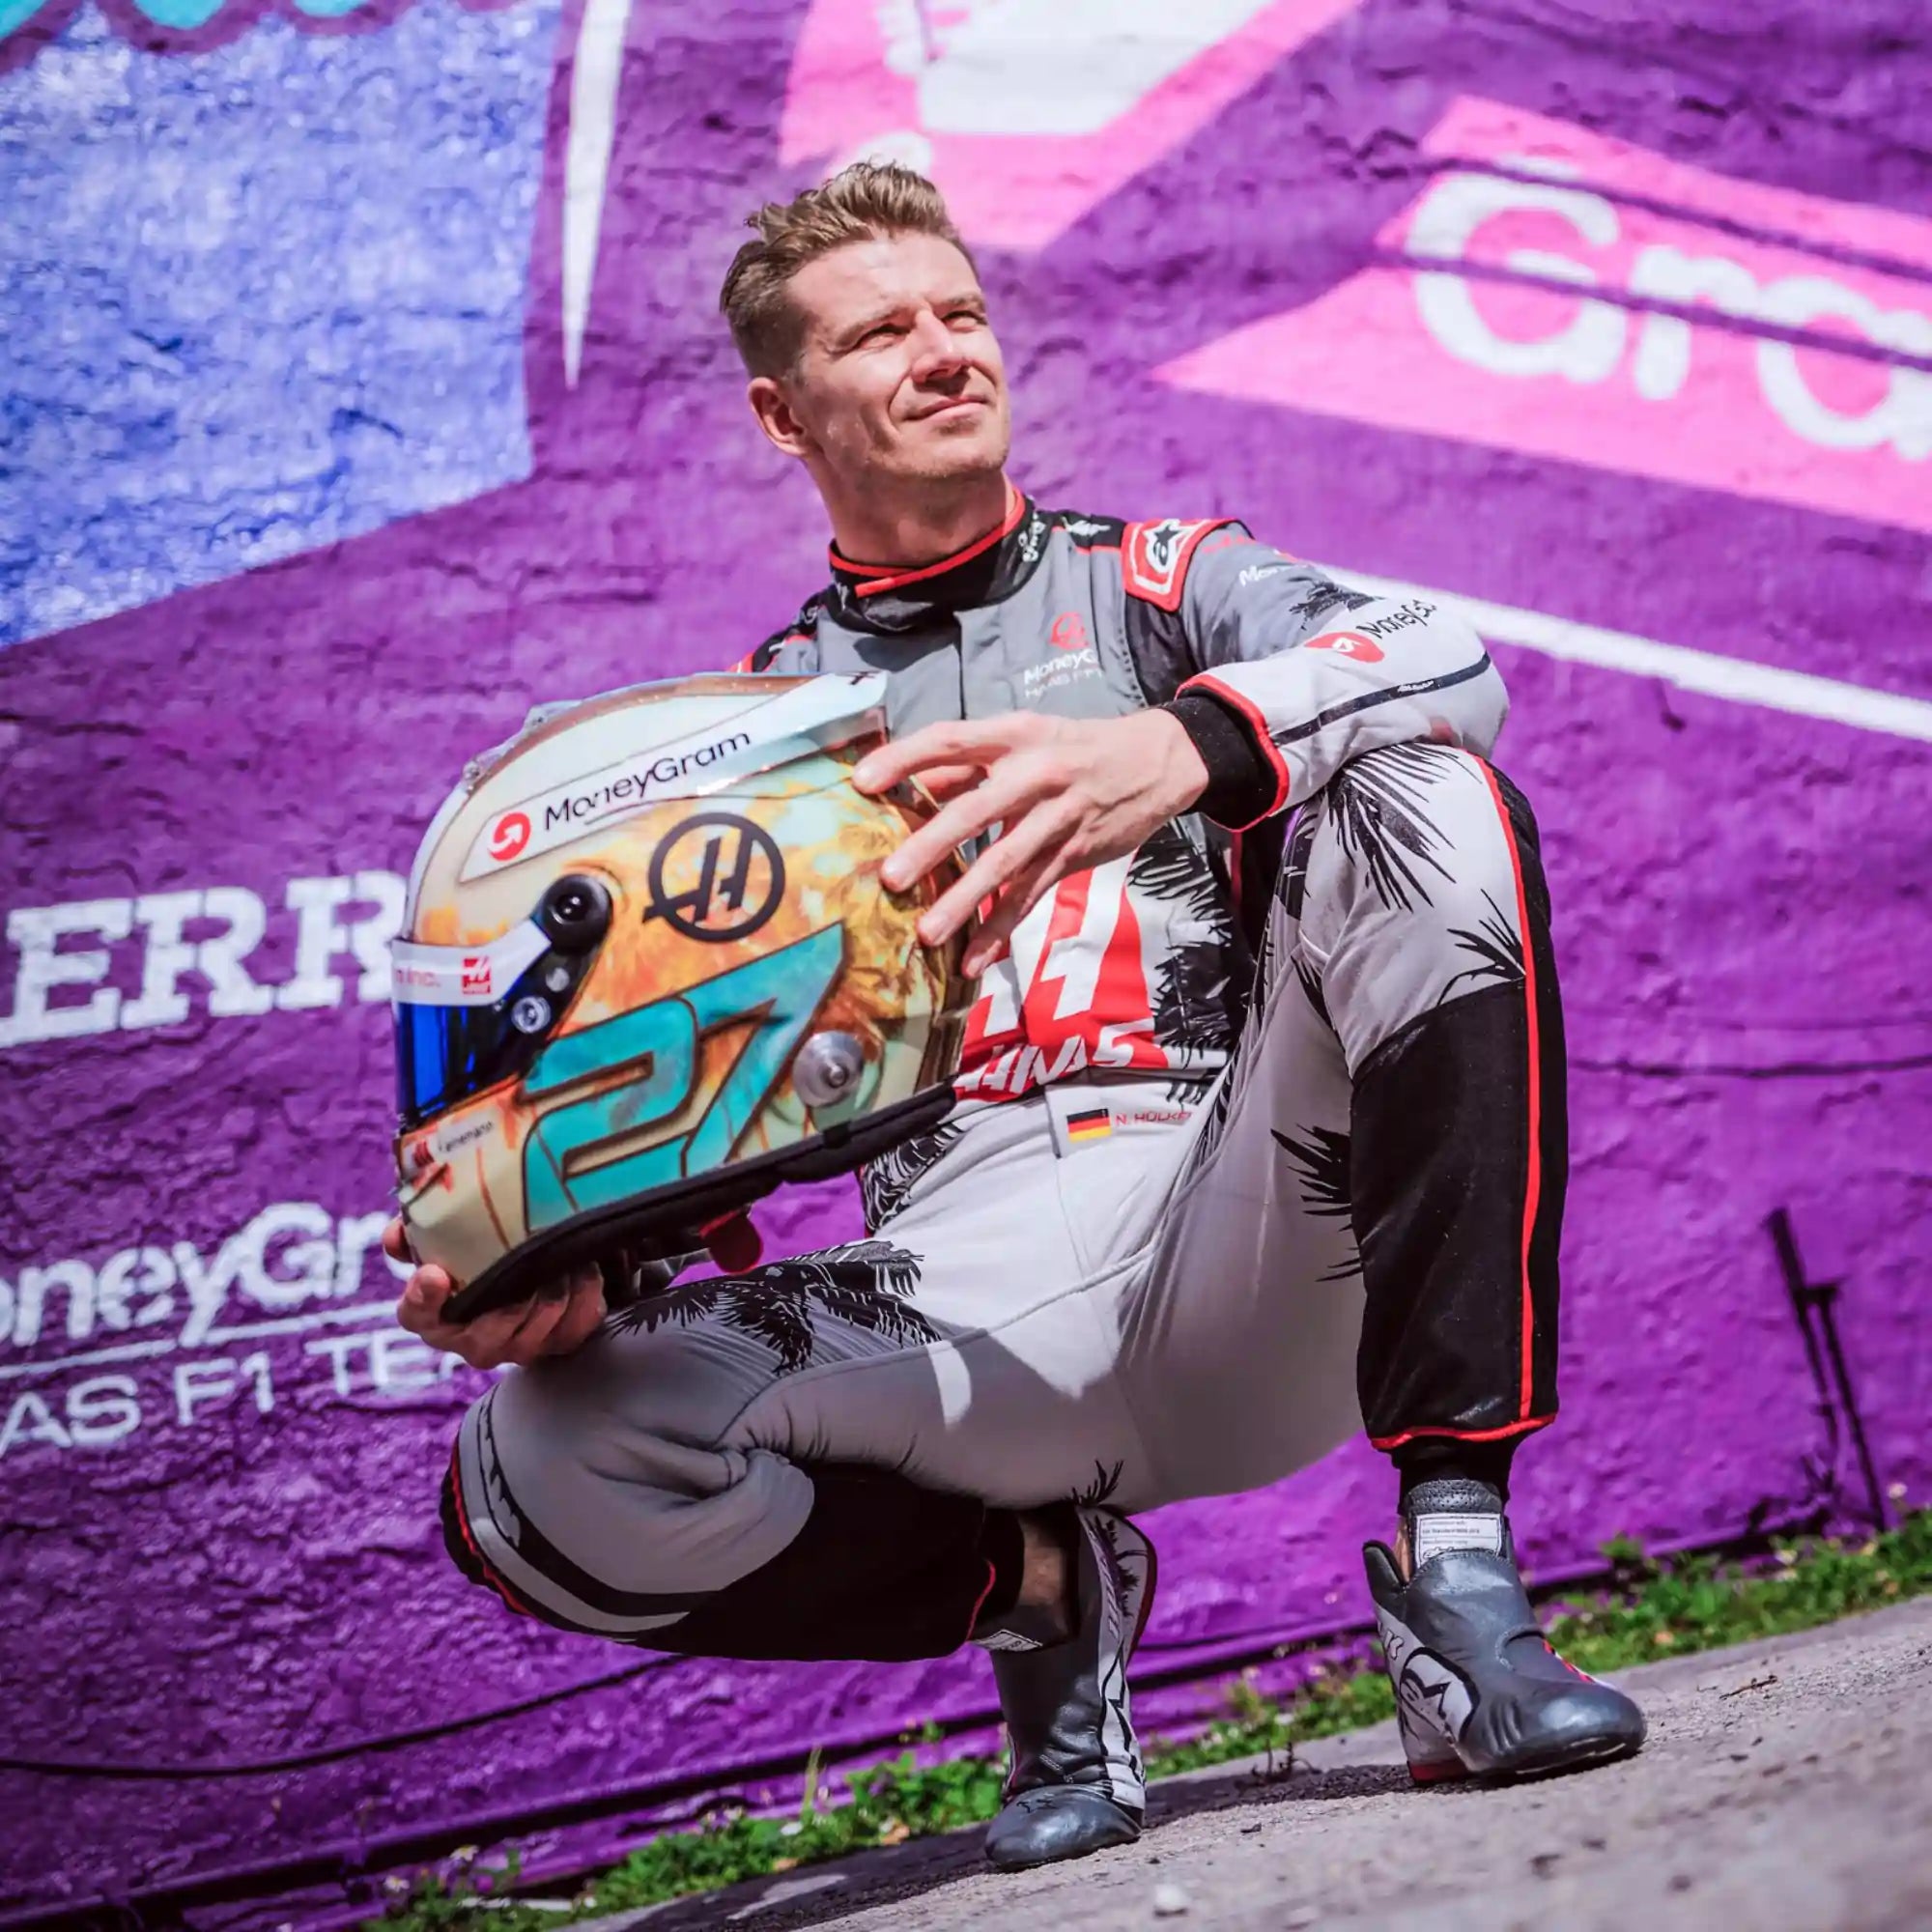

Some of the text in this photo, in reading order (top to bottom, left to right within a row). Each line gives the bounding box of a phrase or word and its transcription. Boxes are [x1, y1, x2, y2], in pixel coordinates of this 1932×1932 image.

[545, 731, 752, 831] MoneyGram
[522, 921, 844, 1234] 27
[0, 1202, 415, 1348] neyGr
[175, 1350, 275, 1427] F1
